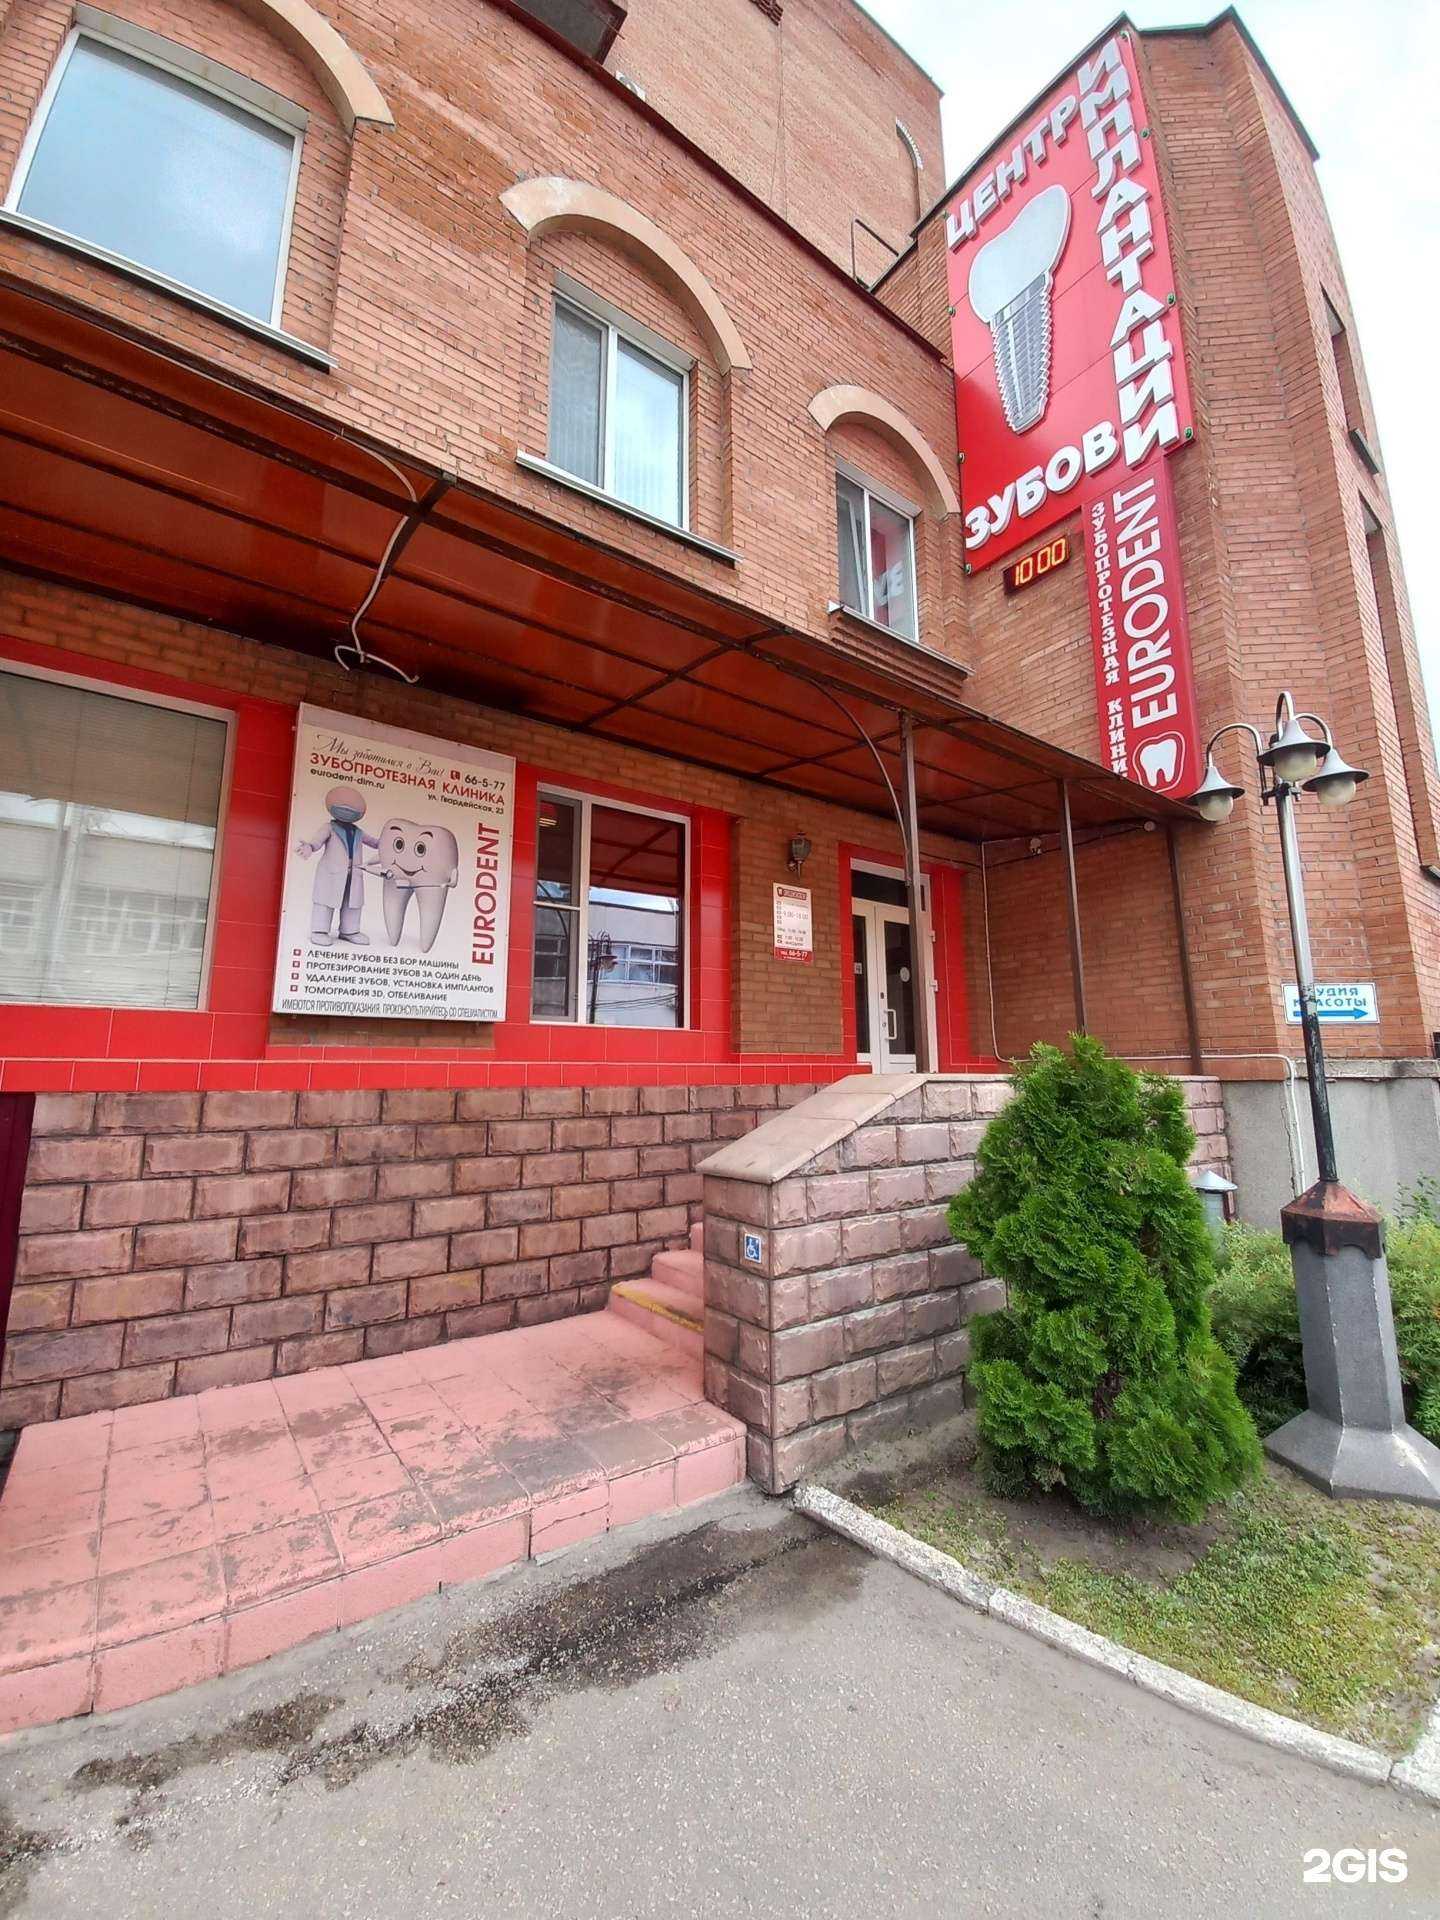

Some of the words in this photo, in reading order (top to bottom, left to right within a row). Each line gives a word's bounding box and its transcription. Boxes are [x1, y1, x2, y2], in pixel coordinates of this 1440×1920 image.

[946, 95, 1081, 253] ЦЕНТР
[1077, 37, 1180, 470] ИМПЛАНТАЦИИ
[965, 420, 1120, 551] ЗУБОВ
[1112, 477, 1178, 729] EURODENT
[1091, 501, 1120, 687] ЗУБОПРОТЕЗНАЯ
[1106, 697, 1128, 777] КЛИНИ
[314, 735, 349, 755] Мы
[310, 768, 385, 789] eurodent-dim.ru
[310, 752, 436, 790] ЗУБОПРОТЕЗНАЯ
[442, 782, 505, 806] КЛИНИКА
[464, 774, 505, 791] 66-5-77
[472, 822, 500, 965] EURODENT
[307, 950, 350, 961] ЛЕЧЕНИЕ
[351, 953, 381, 963] ЗУБОВ
[383, 956, 398, 965] БЕЗ
[400, 957, 417, 966] БОР
[419, 959, 459, 969] МАШИНЫ
[306, 961, 390, 975] ПРОТЕЗИРОВАНИЕ
[392, 967, 420, 978] ЗУБОВ
[422, 970, 433, 978] ЗА
[435, 971, 459, 980] ОДИН
[461, 973, 482, 982] ДЕНЬ
[304, 985, 370, 997] ТОМОГРАФИЯ
[387, 990, 448, 1001] ОТБЕЛИВАНИЕ
[306, 973, 356, 985] УДАЛЕНИЕ
[358, 977, 390, 987] ЗУБОВ,
[393, 980, 443, 990] УСТАНОВКА
[445, 983, 494, 993] ИМПЛАНТОВ
[1316, 987, 1358, 996] УДИЯ
[1294, 998, 1367, 1007] КАСОТЫ
